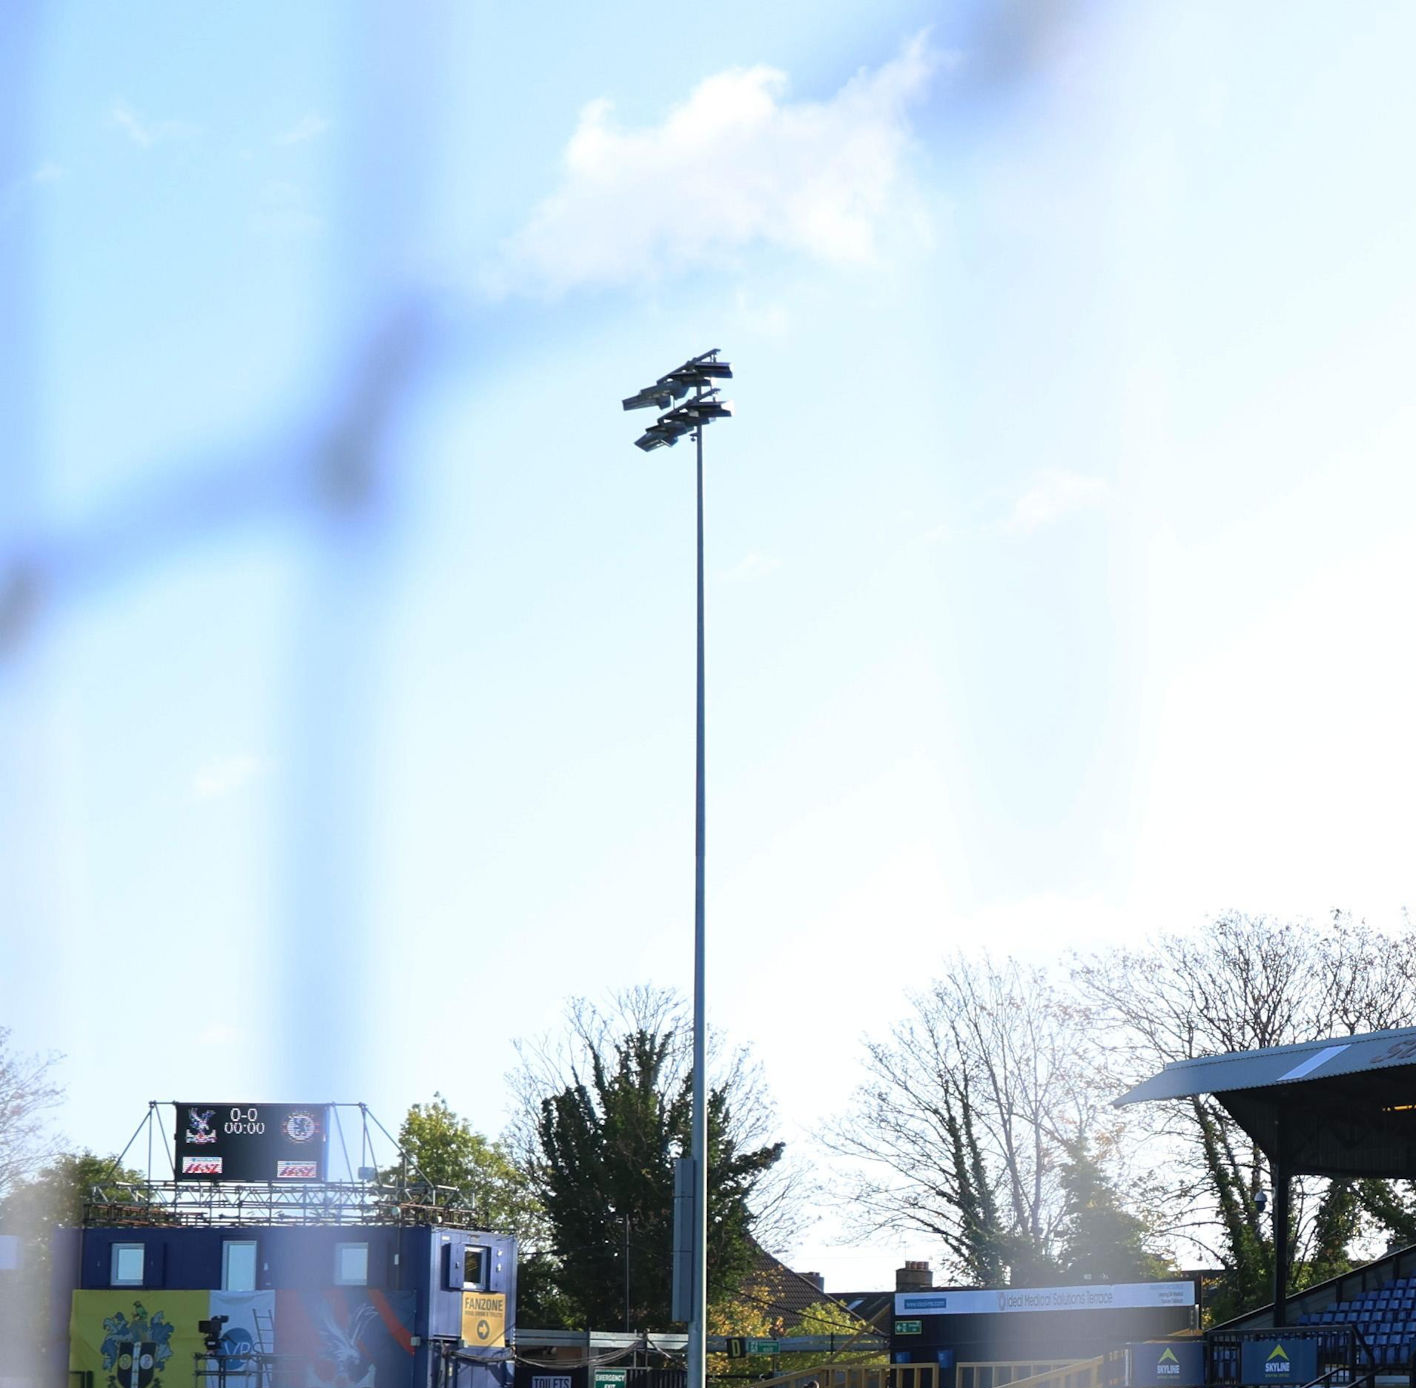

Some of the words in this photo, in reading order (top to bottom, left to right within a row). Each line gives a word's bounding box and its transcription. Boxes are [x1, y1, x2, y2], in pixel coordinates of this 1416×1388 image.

[224, 1122, 265, 1134] 00:00
[465, 1297, 503, 1311] FANZONE
[1157, 1364, 1180, 1374] SKYLINE
[1265, 1362, 1290, 1373] SKYLINE
